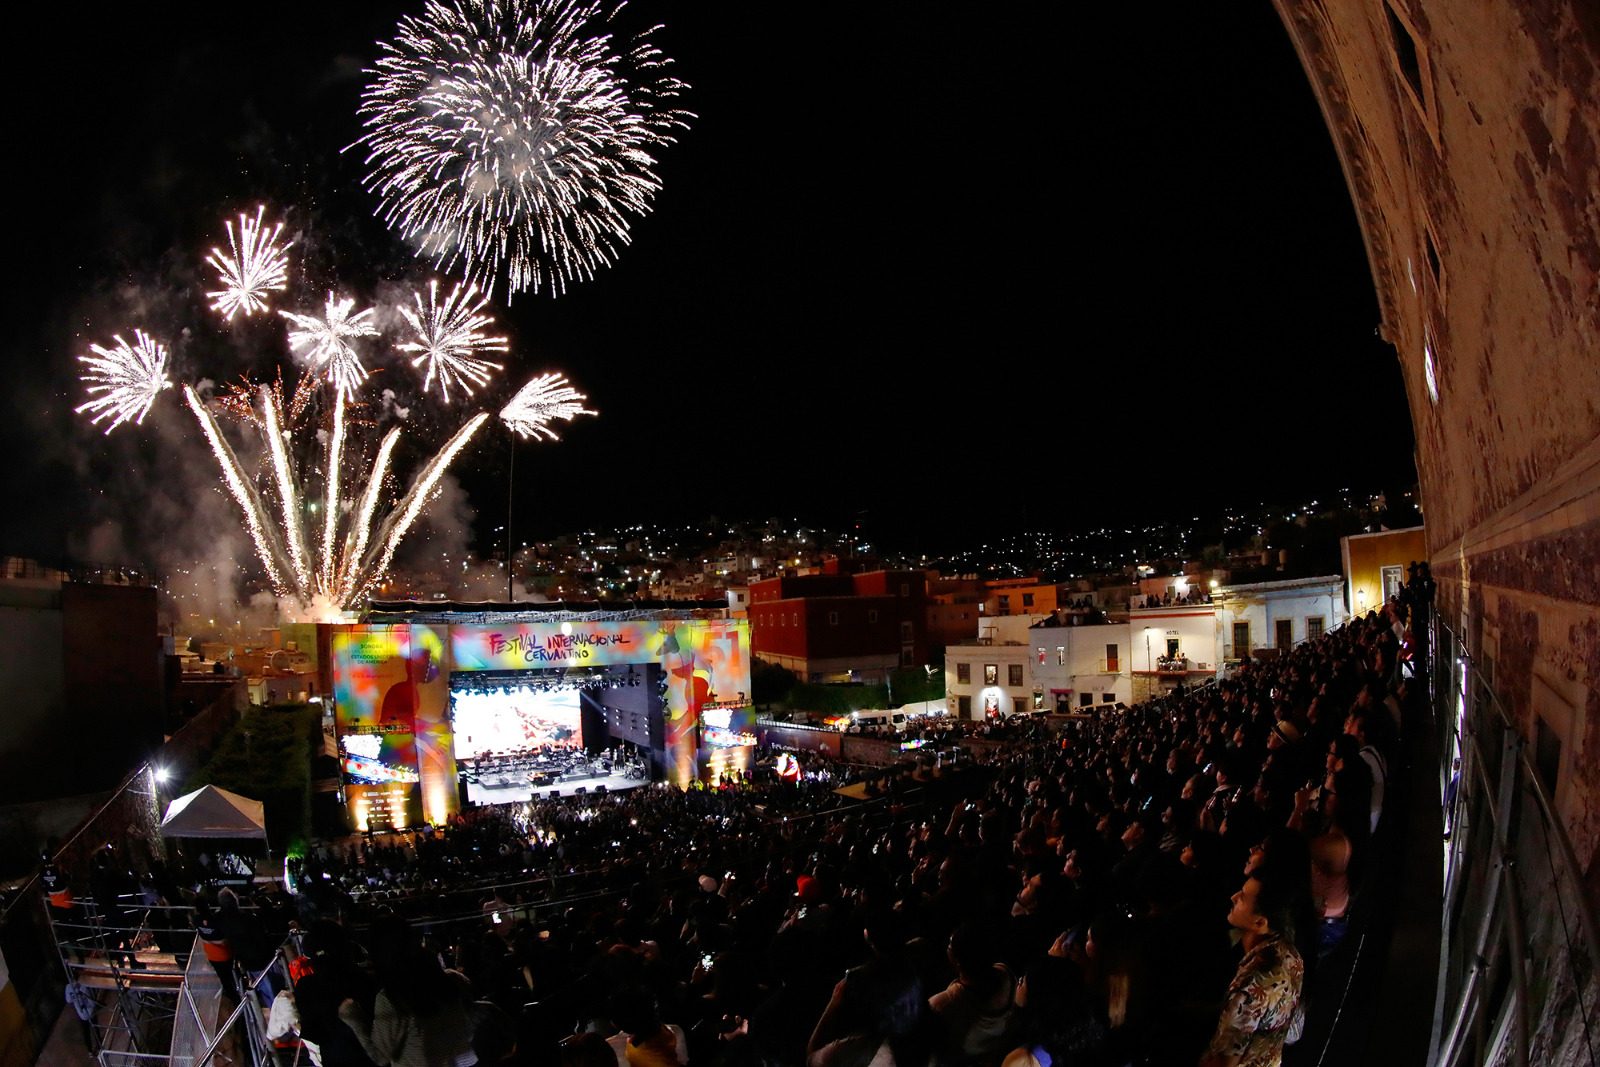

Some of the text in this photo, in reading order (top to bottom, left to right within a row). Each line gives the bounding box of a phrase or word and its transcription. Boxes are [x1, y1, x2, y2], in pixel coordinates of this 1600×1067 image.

[489, 633, 631, 656] FESTIVAL INTERNACIONAL
[524, 648, 589, 662] CERVANTINO
[703, 631, 740, 667] 51
